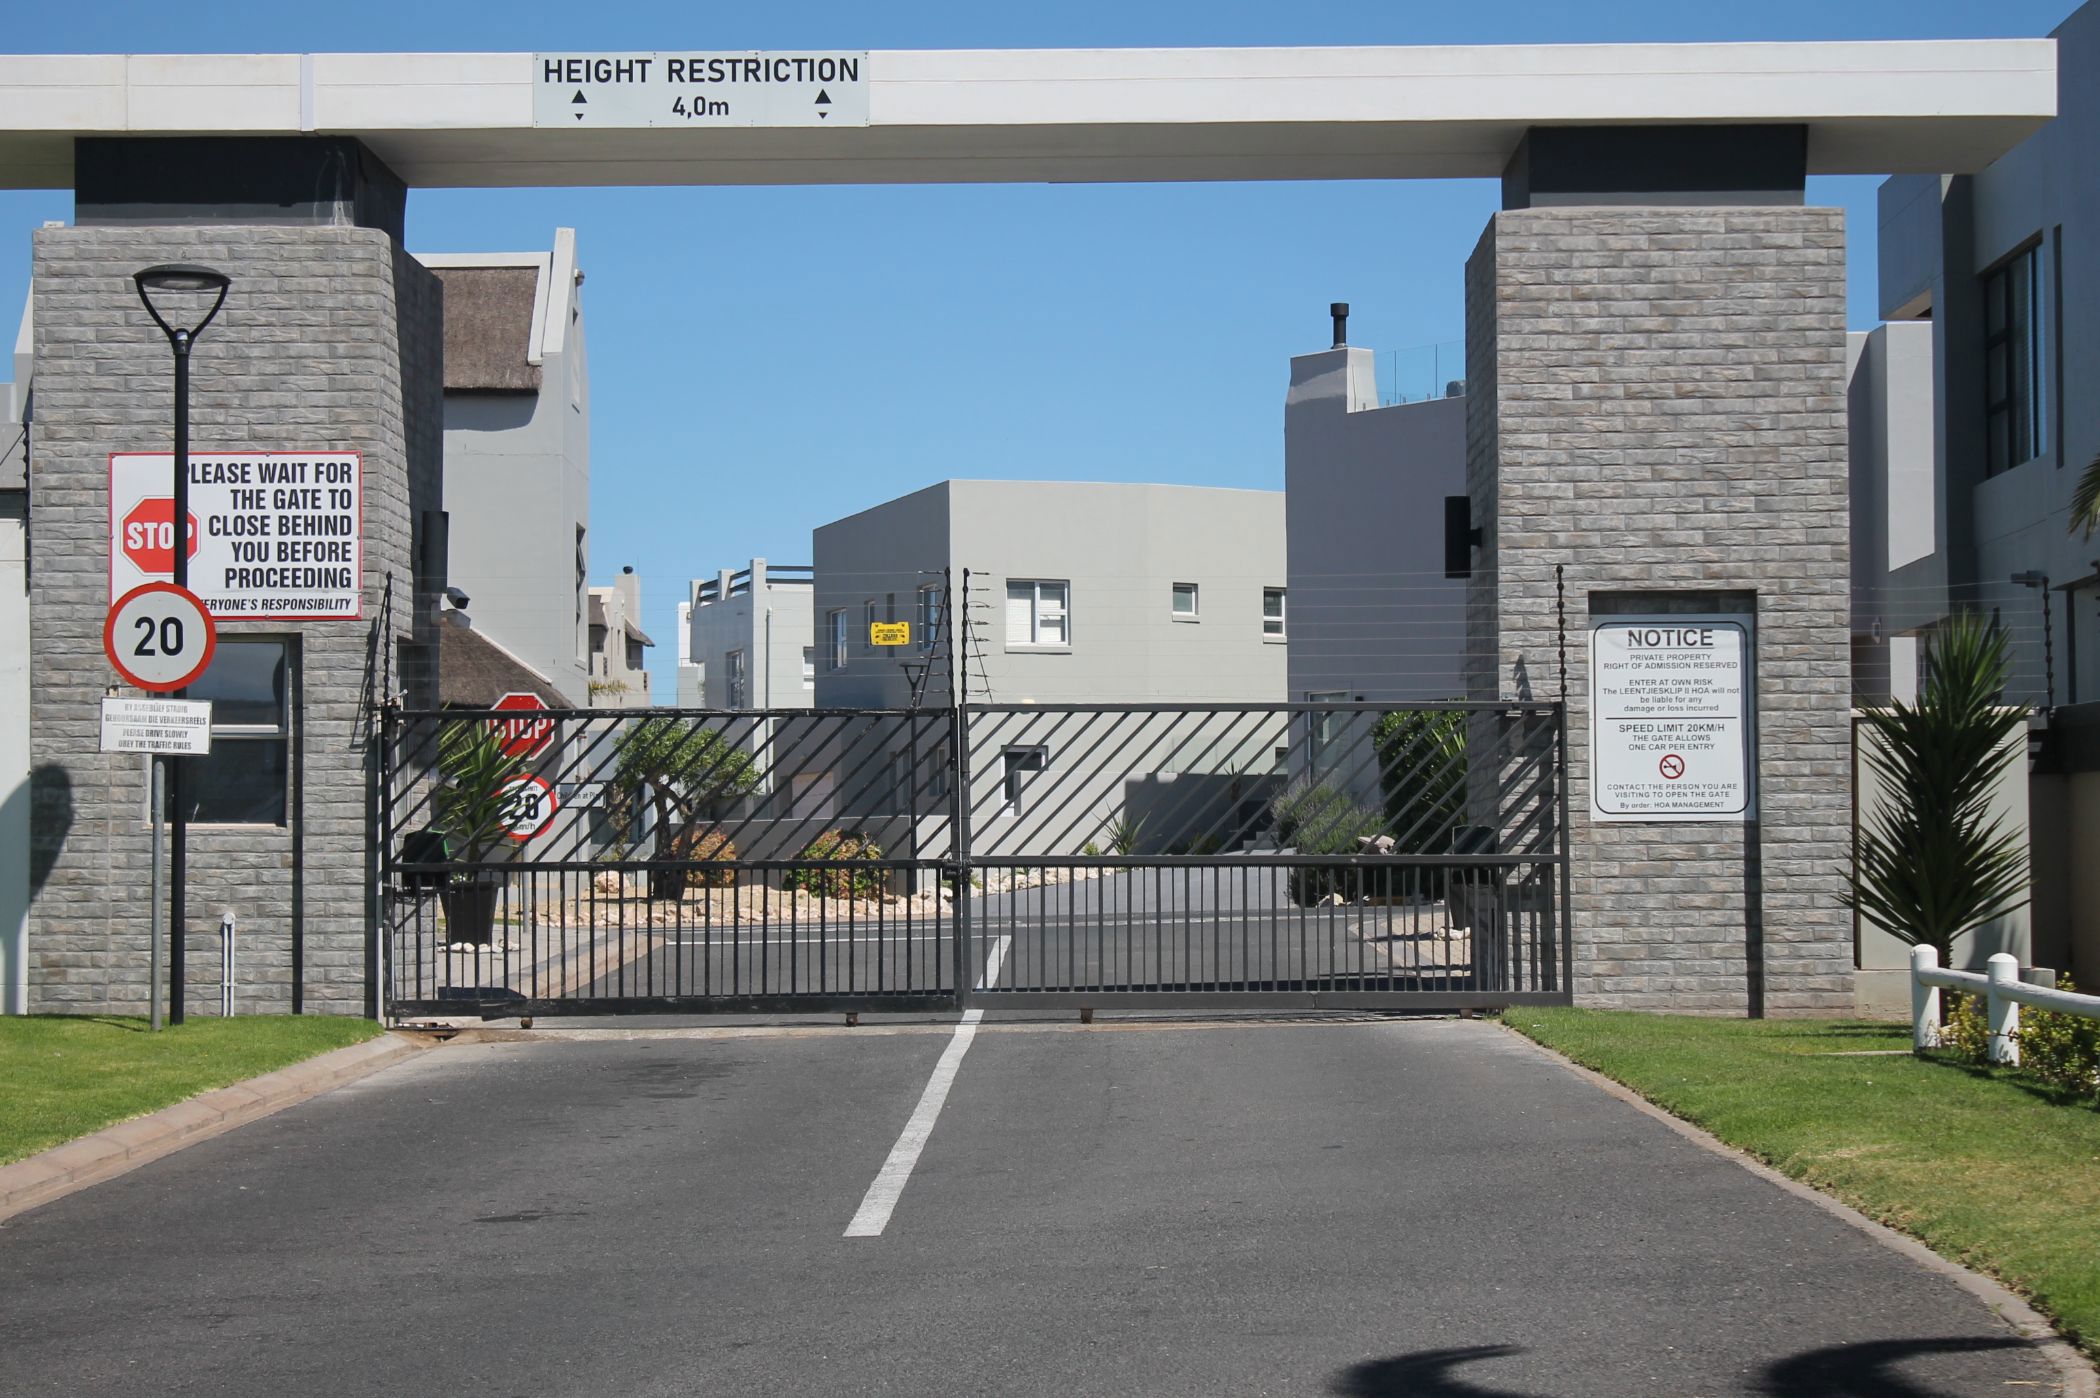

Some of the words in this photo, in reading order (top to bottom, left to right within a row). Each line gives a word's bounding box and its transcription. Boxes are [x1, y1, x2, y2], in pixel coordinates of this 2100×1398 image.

[544, 59, 652, 83] HEIGHT
[667, 58, 858, 82] RESTRICTION
[672, 96, 729, 120] 4,0m
[188, 462, 250, 484] LEASE
[258, 463, 308, 484] WAIT
[315, 462, 352, 484] FOR
[230, 489, 266, 510] THE
[274, 489, 322, 510] GATE
[328, 489, 352, 510] TO
[209, 515, 270, 536] CLOSE
[278, 515, 352, 536] BEHIND
[231, 542, 269, 562] YOU
[278, 542, 352, 562] BEFORE
[225, 568, 352, 589] PROCEEDING
[200, 599, 257, 610] ERYONE'S
[261, 599, 351, 610] RESPONSIBILITY
[134, 616, 184, 656] 20
[1628, 629, 1713, 647] NOTICE
[1624, 705, 1654, 713] damage
[148, 716, 158, 724] DIE
[1619, 724, 1654, 732] SPEED
[1657, 724, 1684, 732] LIMIT
[1687, 724, 1725, 732] 20KM/H
[145, 730, 163, 738] DRIVE
[165, 730, 188, 738] SLOWLY
[148, 741, 172, 749] TRAFFIC
